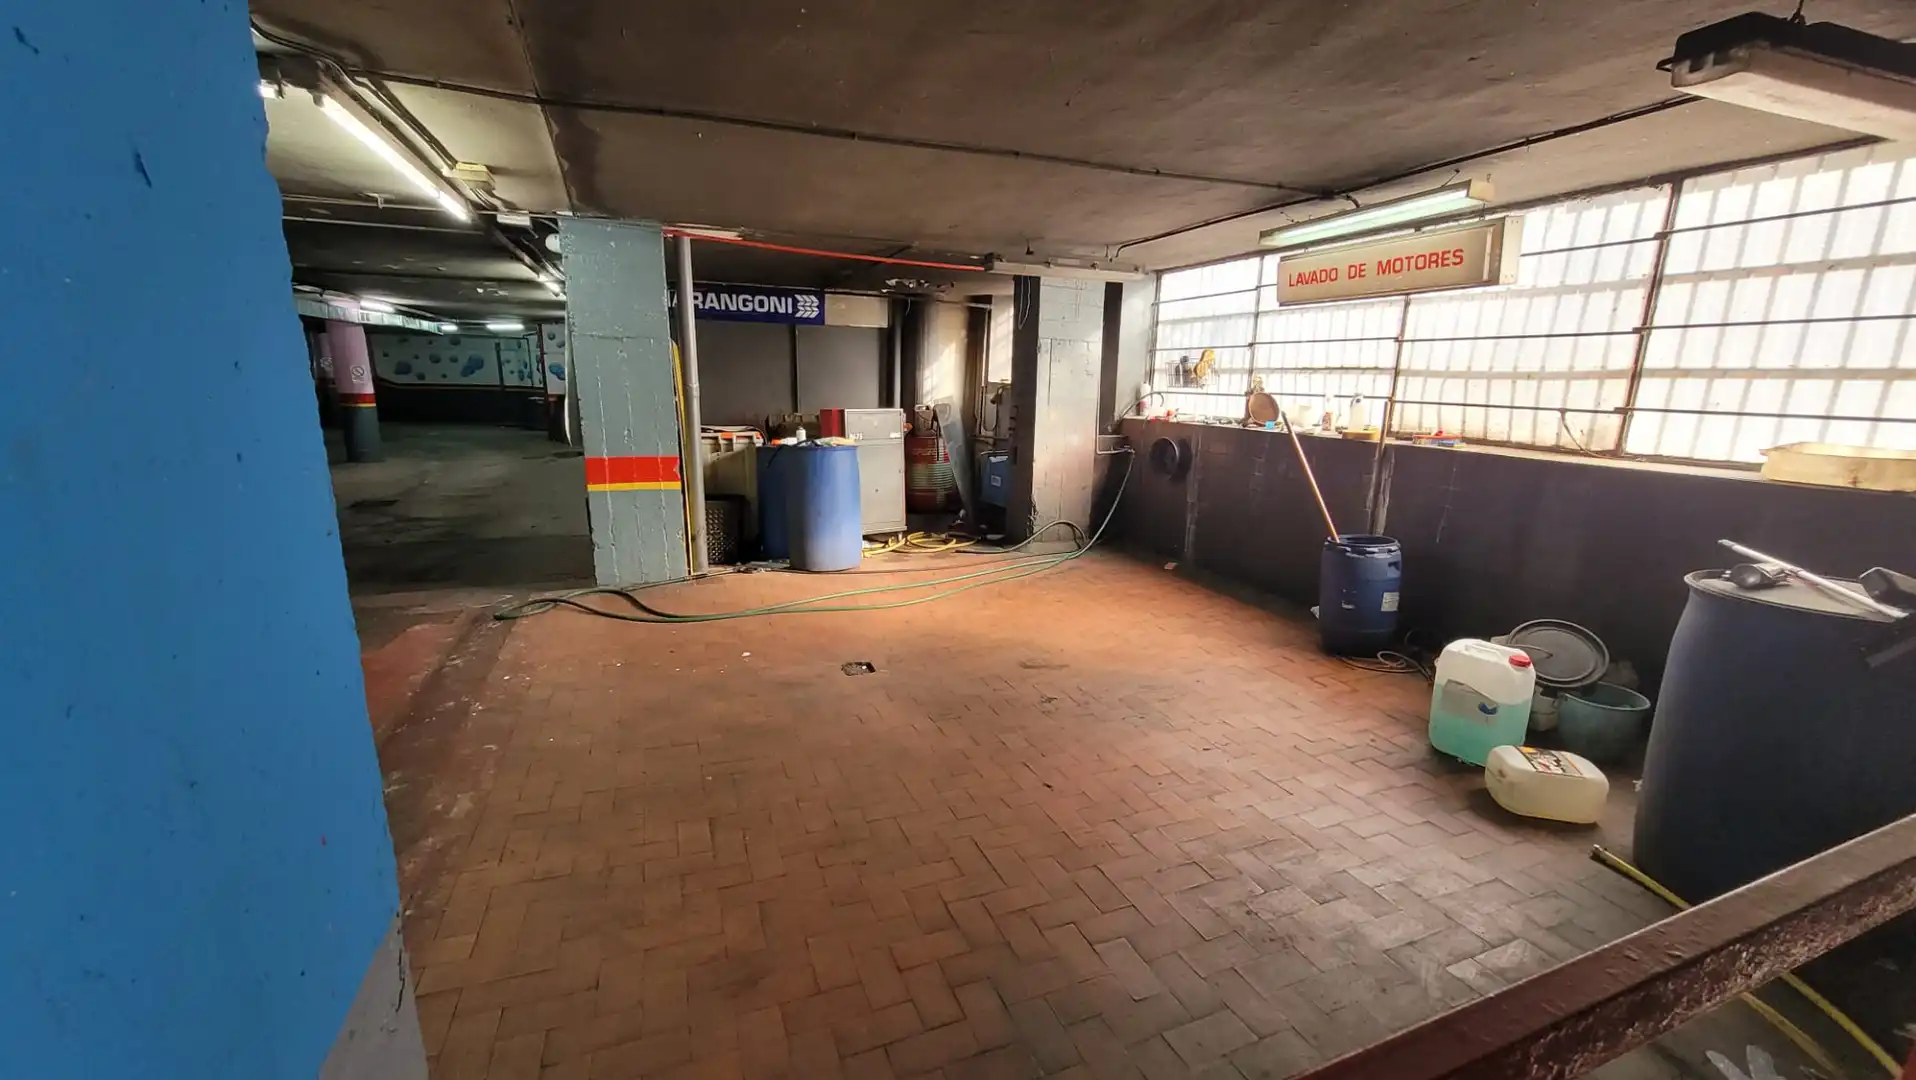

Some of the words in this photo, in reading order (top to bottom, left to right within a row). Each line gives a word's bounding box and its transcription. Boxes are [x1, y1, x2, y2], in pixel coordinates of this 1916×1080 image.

[1288, 267, 1338, 287] LAVADO
[1347, 263, 1367, 280] DE
[1376, 248, 1464, 276] MOTORES
[667, 289, 792, 314] RANGONI
